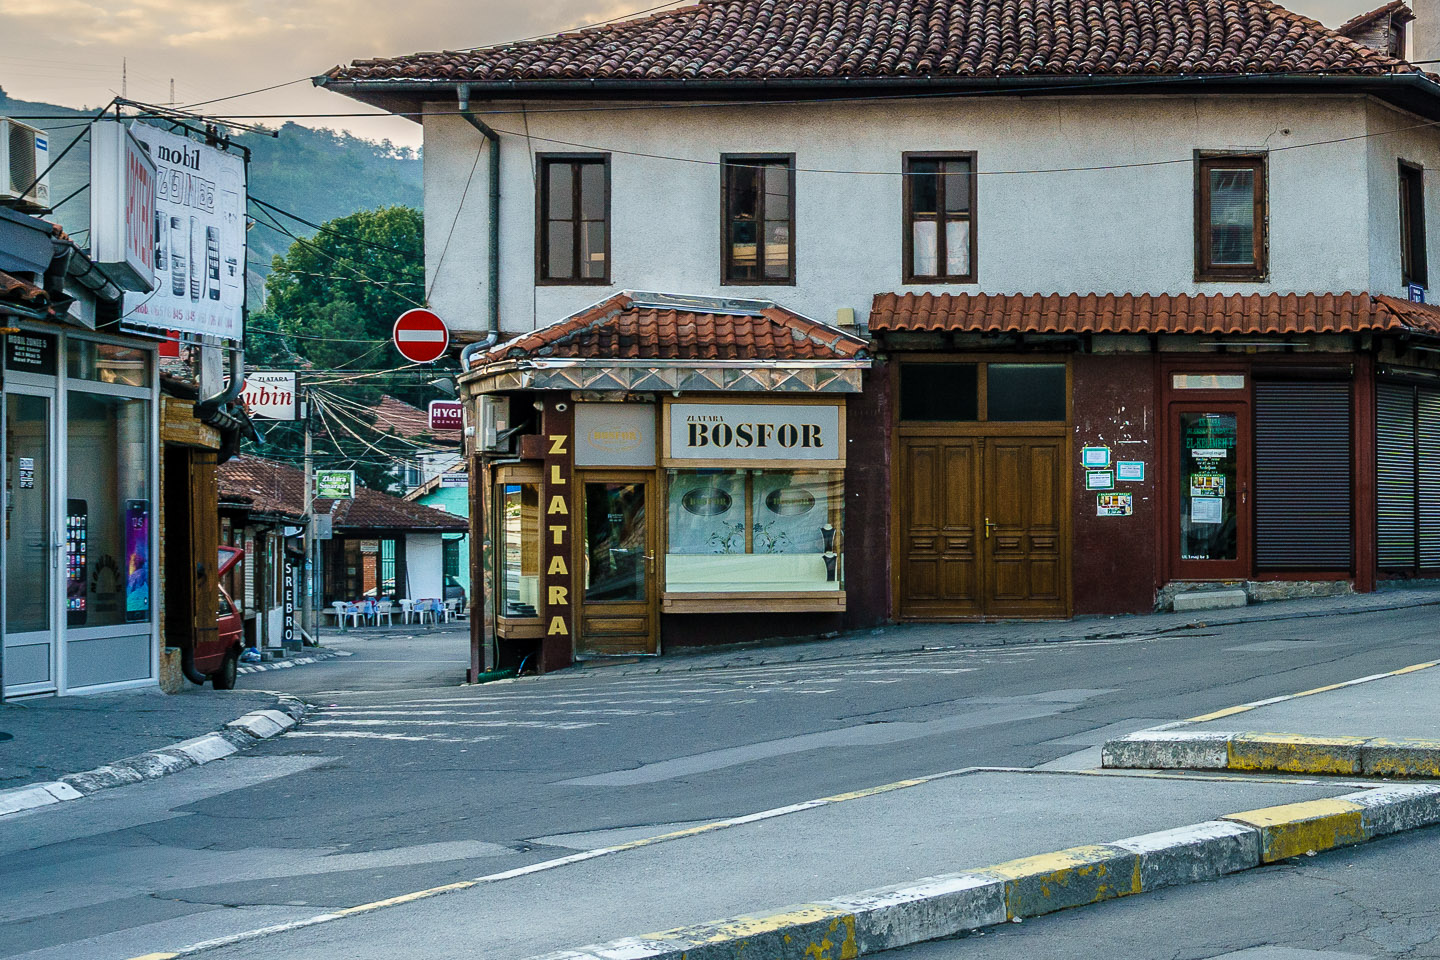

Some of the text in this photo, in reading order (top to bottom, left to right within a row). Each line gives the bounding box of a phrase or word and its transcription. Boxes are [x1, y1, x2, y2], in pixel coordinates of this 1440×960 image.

[158, 144, 200, 170] mobil
[126, 146, 155, 273] APOTEKA
[241, 378, 293, 406] ubin
[687, 423, 824, 448] BOSFOR
[319, 482, 349, 490] Smaragd
[547, 434, 569, 636] ZLATARA
[285, 563, 293, 640] SREBRO
